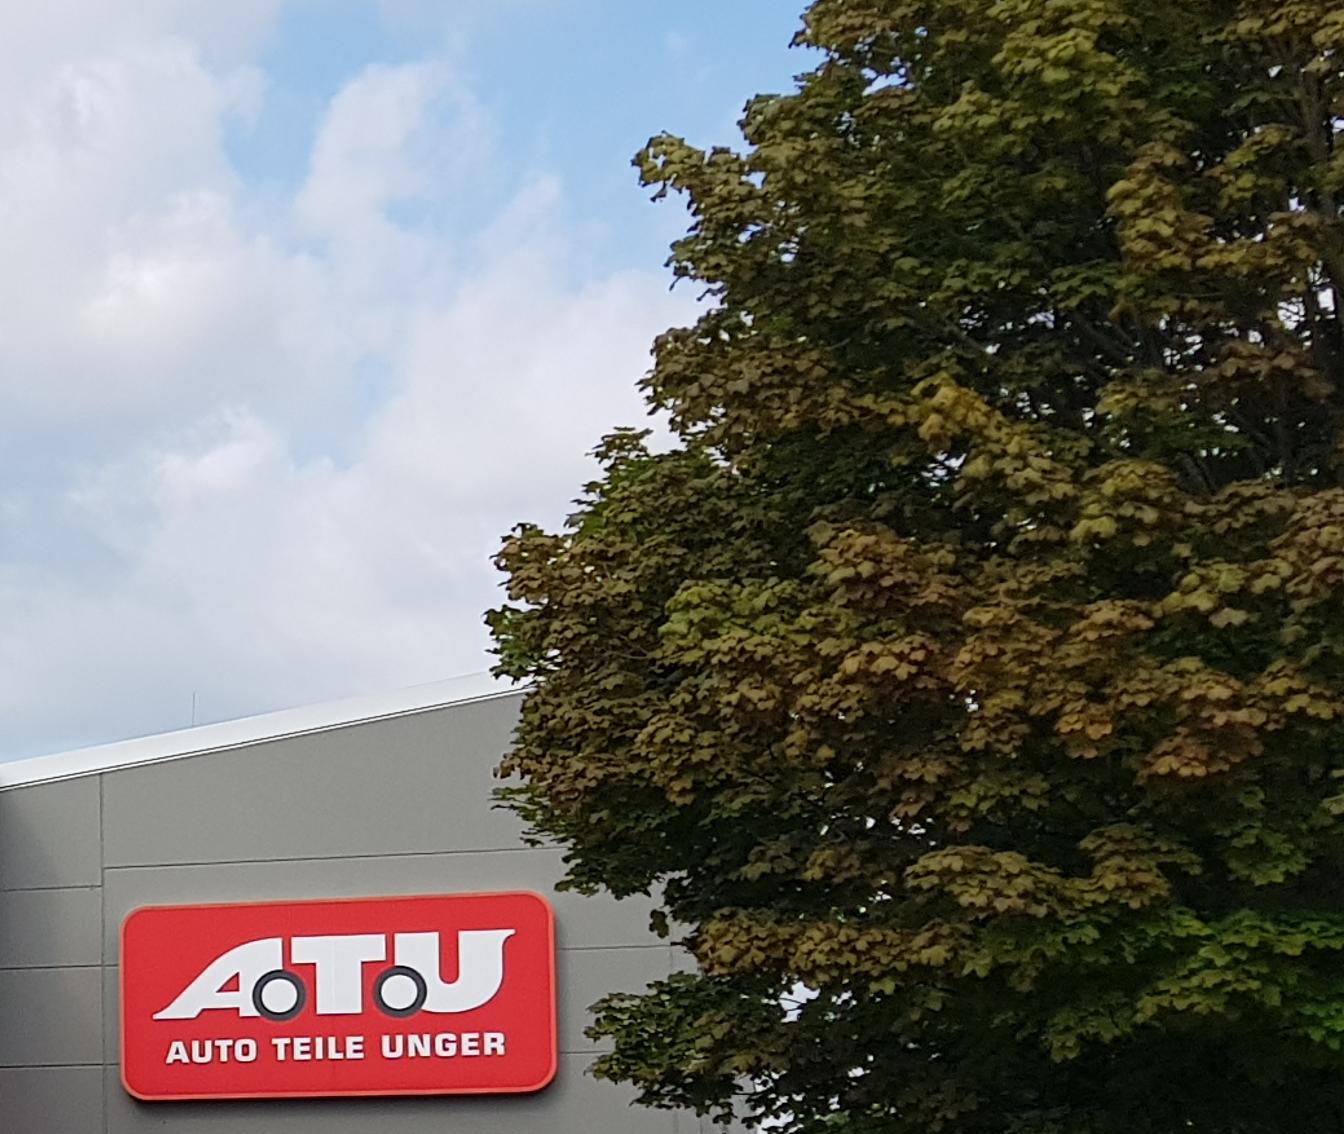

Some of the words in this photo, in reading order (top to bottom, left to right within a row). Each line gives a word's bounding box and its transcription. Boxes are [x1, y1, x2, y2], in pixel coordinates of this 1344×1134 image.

[165, 1038, 257, 1065] AUTO
[272, 1035, 365, 1062] TEILE
[381, 1032, 506, 1058] UNGER
